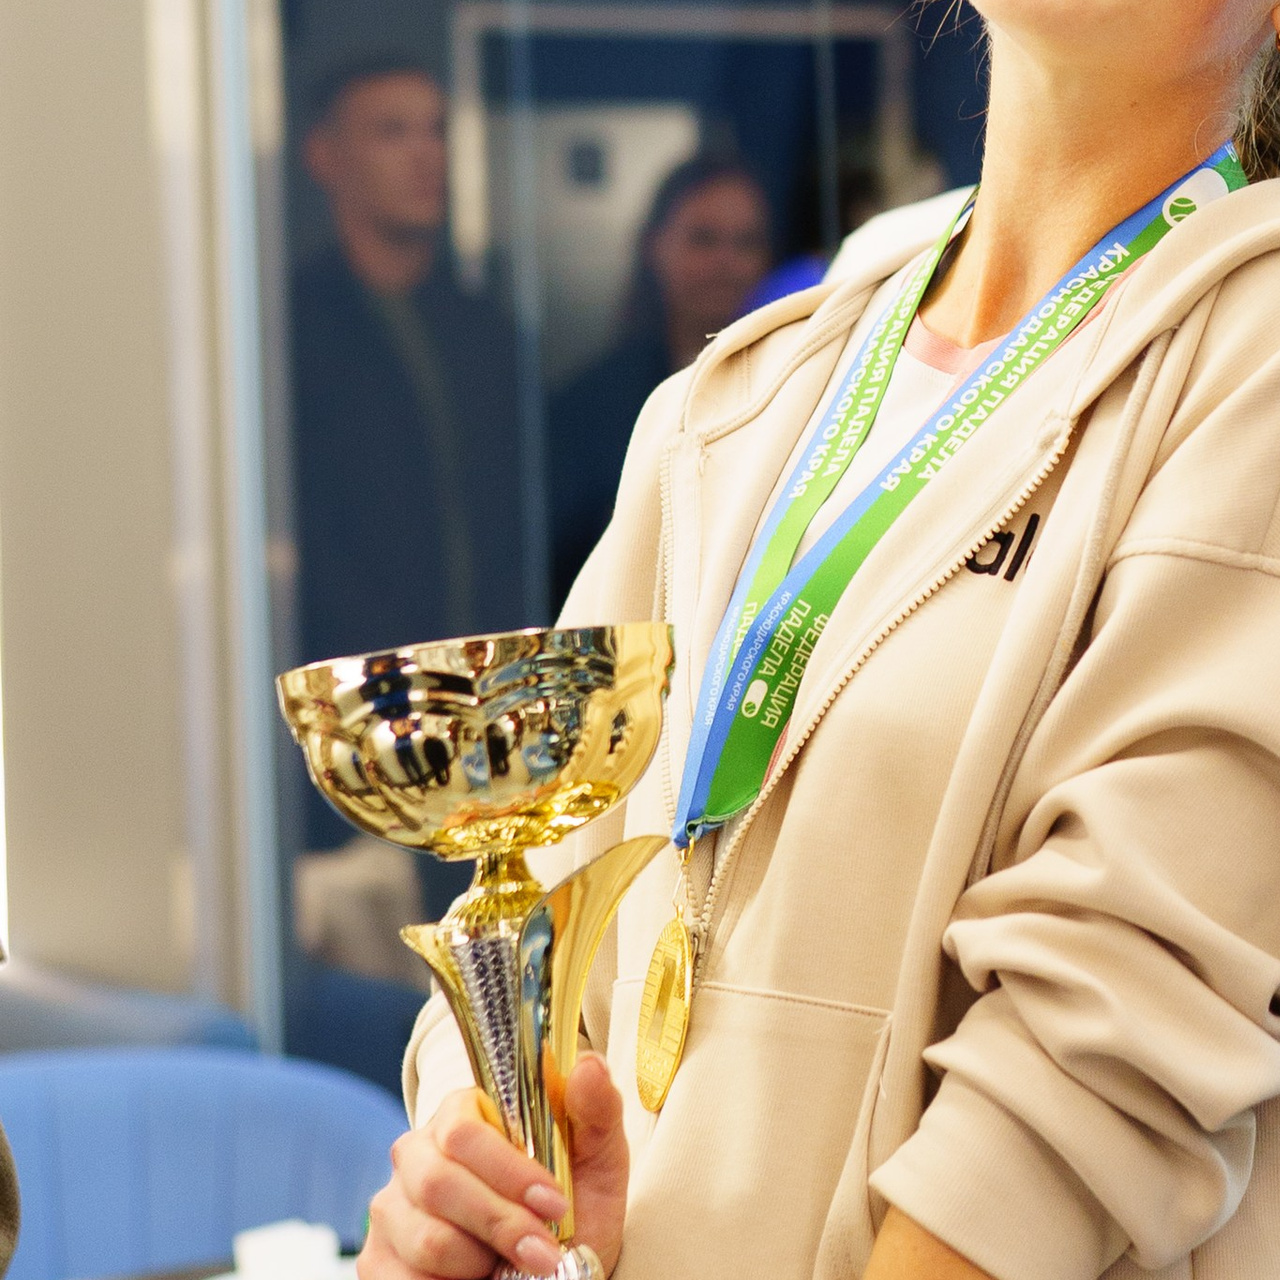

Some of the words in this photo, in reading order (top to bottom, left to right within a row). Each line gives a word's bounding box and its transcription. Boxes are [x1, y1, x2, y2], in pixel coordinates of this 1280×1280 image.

[935, 242, 1131, 431] КРАСНОДАРСКОГО
[788, 443, 831, 499] КРАЯ
[822, 385, 879, 478] ПАДЕЛА
[880, 432, 938, 493] КРАЯ
[916, 390, 1004, 481] ПАДЕЛА
[737, 590, 793, 682] КРАСНОДАРСКОГО
[758, 599, 812, 677] ПАДЕЛА
[760, 613, 829, 729] ФЕДЕРАЦИЯ
[725, 682, 744, 712] КРАЯ
